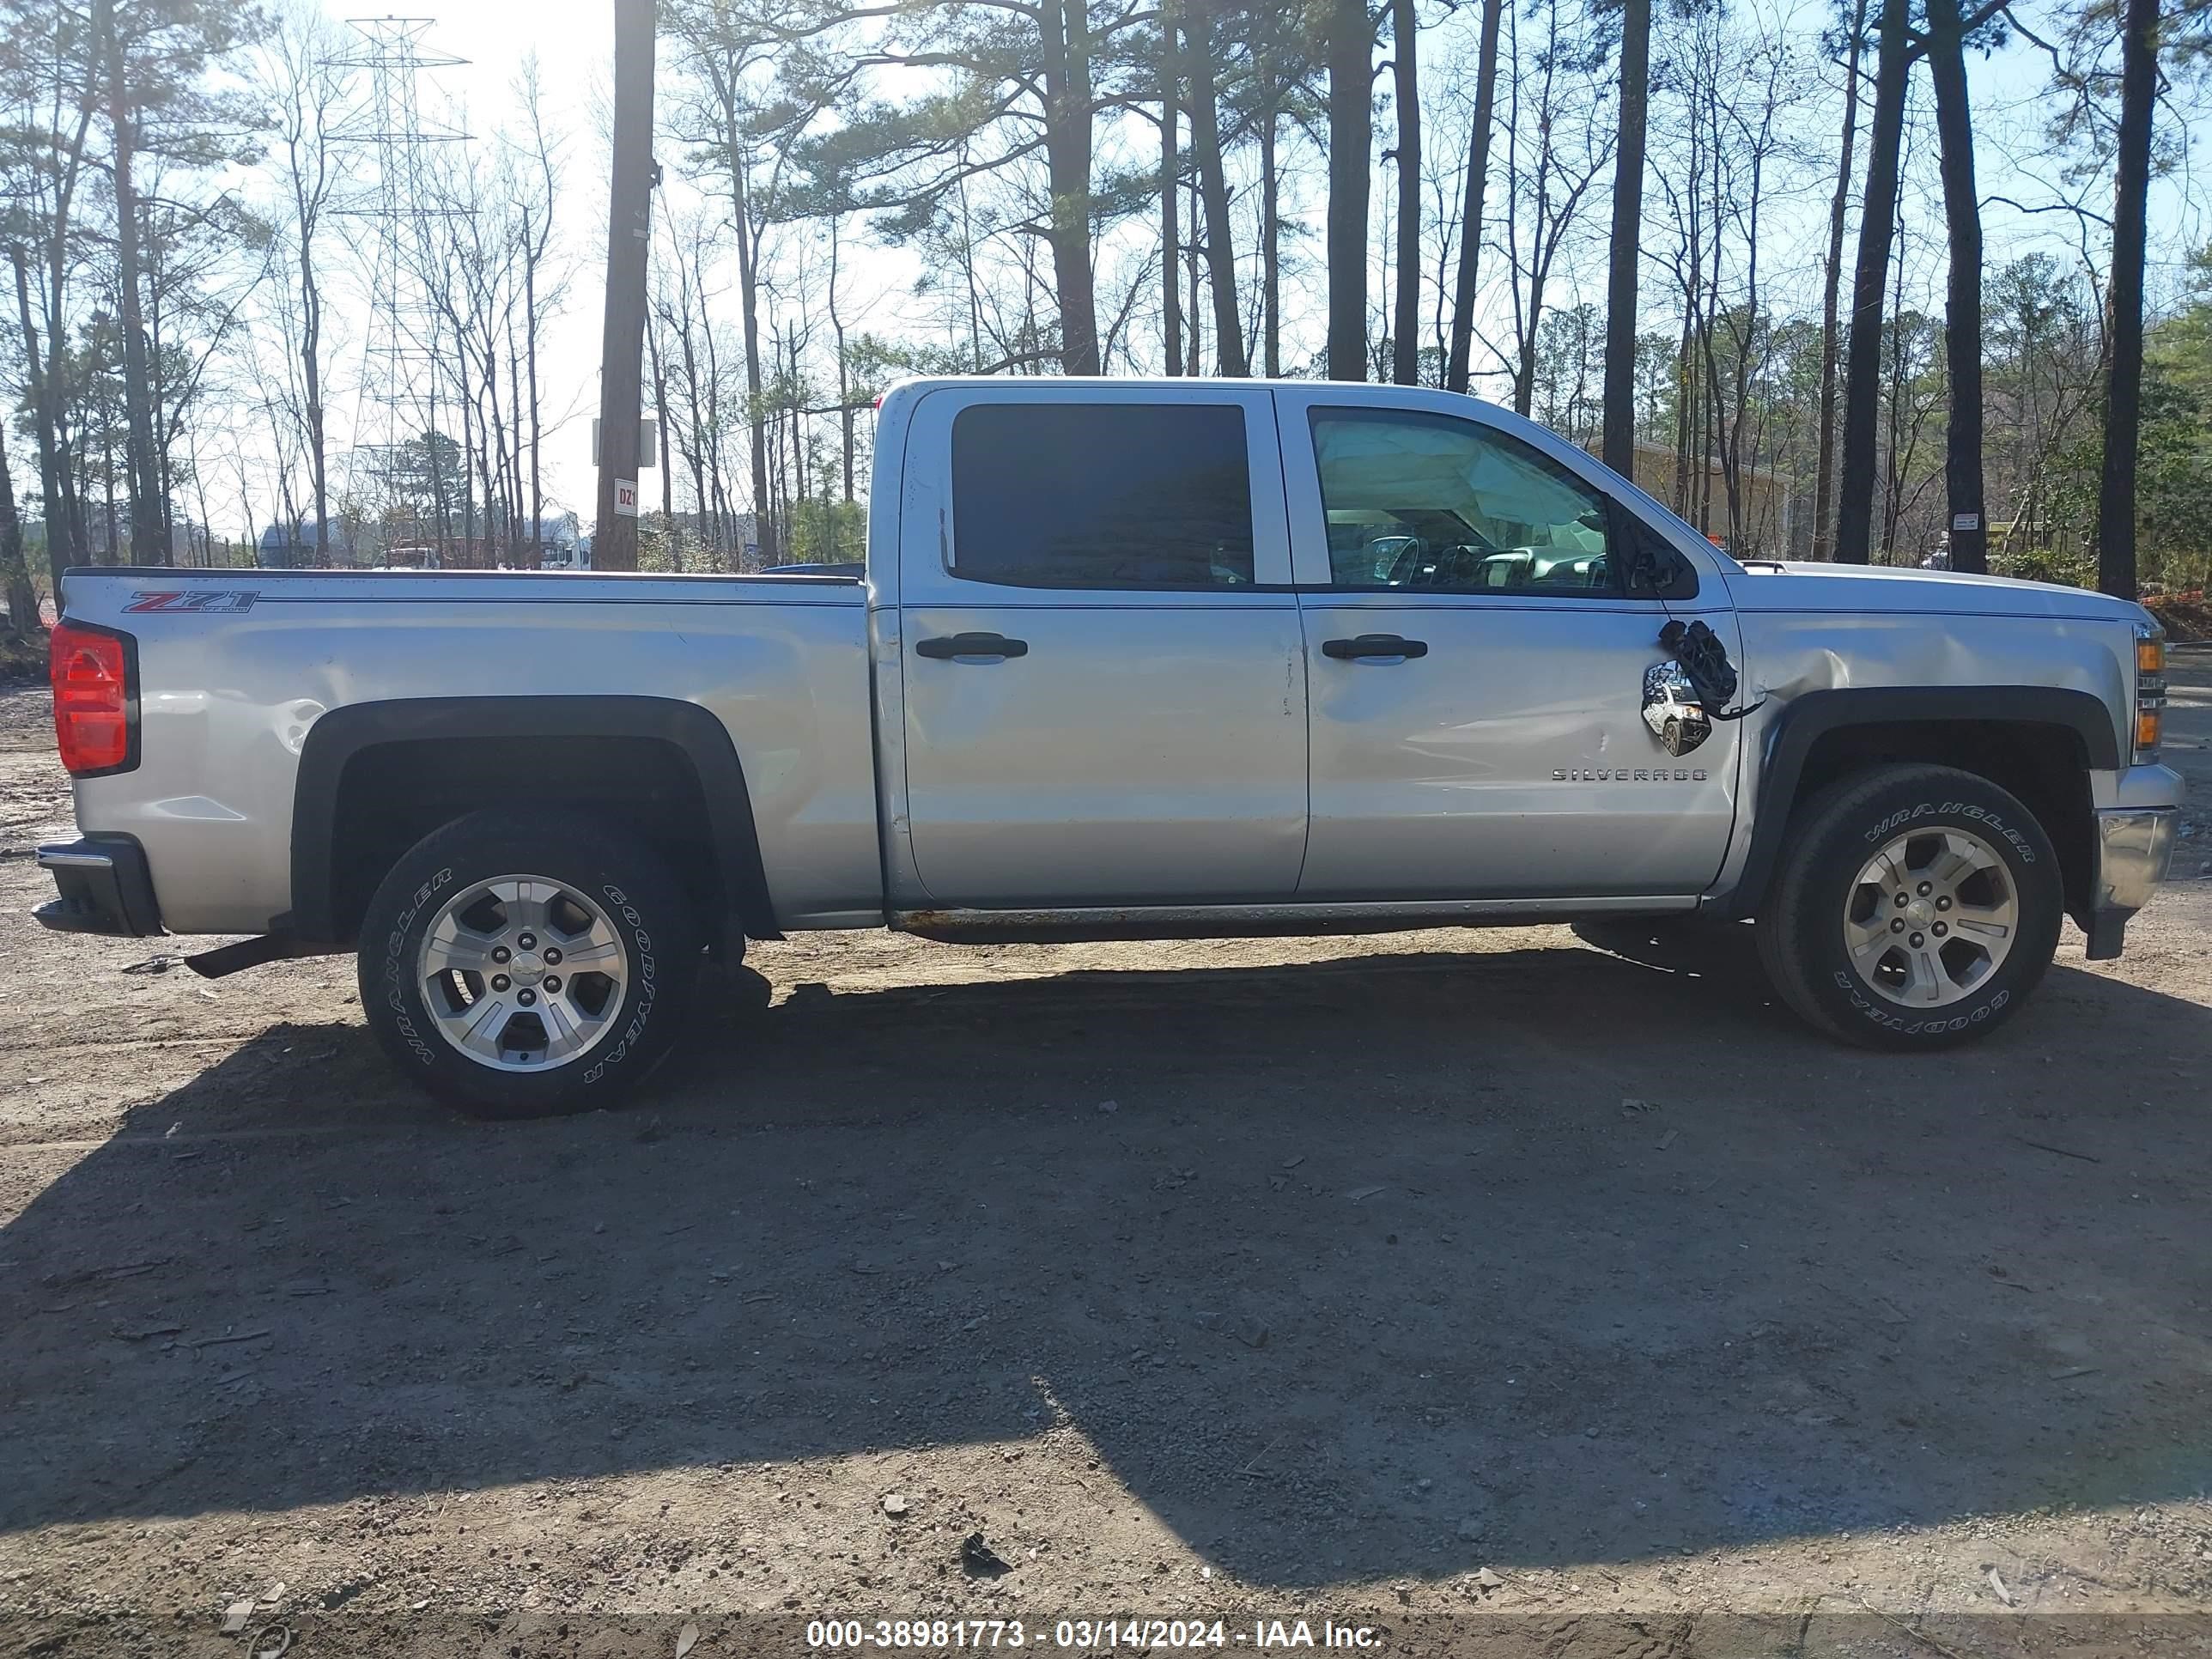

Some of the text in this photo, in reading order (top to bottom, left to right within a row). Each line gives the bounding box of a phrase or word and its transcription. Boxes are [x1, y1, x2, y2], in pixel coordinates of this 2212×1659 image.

[120, 591, 261, 613] Z71
[1552, 769, 1708, 781] SILVERADO
[1864, 802, 2036, 864] WRANGLER
[385, 866, 453, 1065] WRANGLER
[584, 884, 656, 1085] GOODYEAR
[1833, 970, 2010, 1035] GOODYEAR
